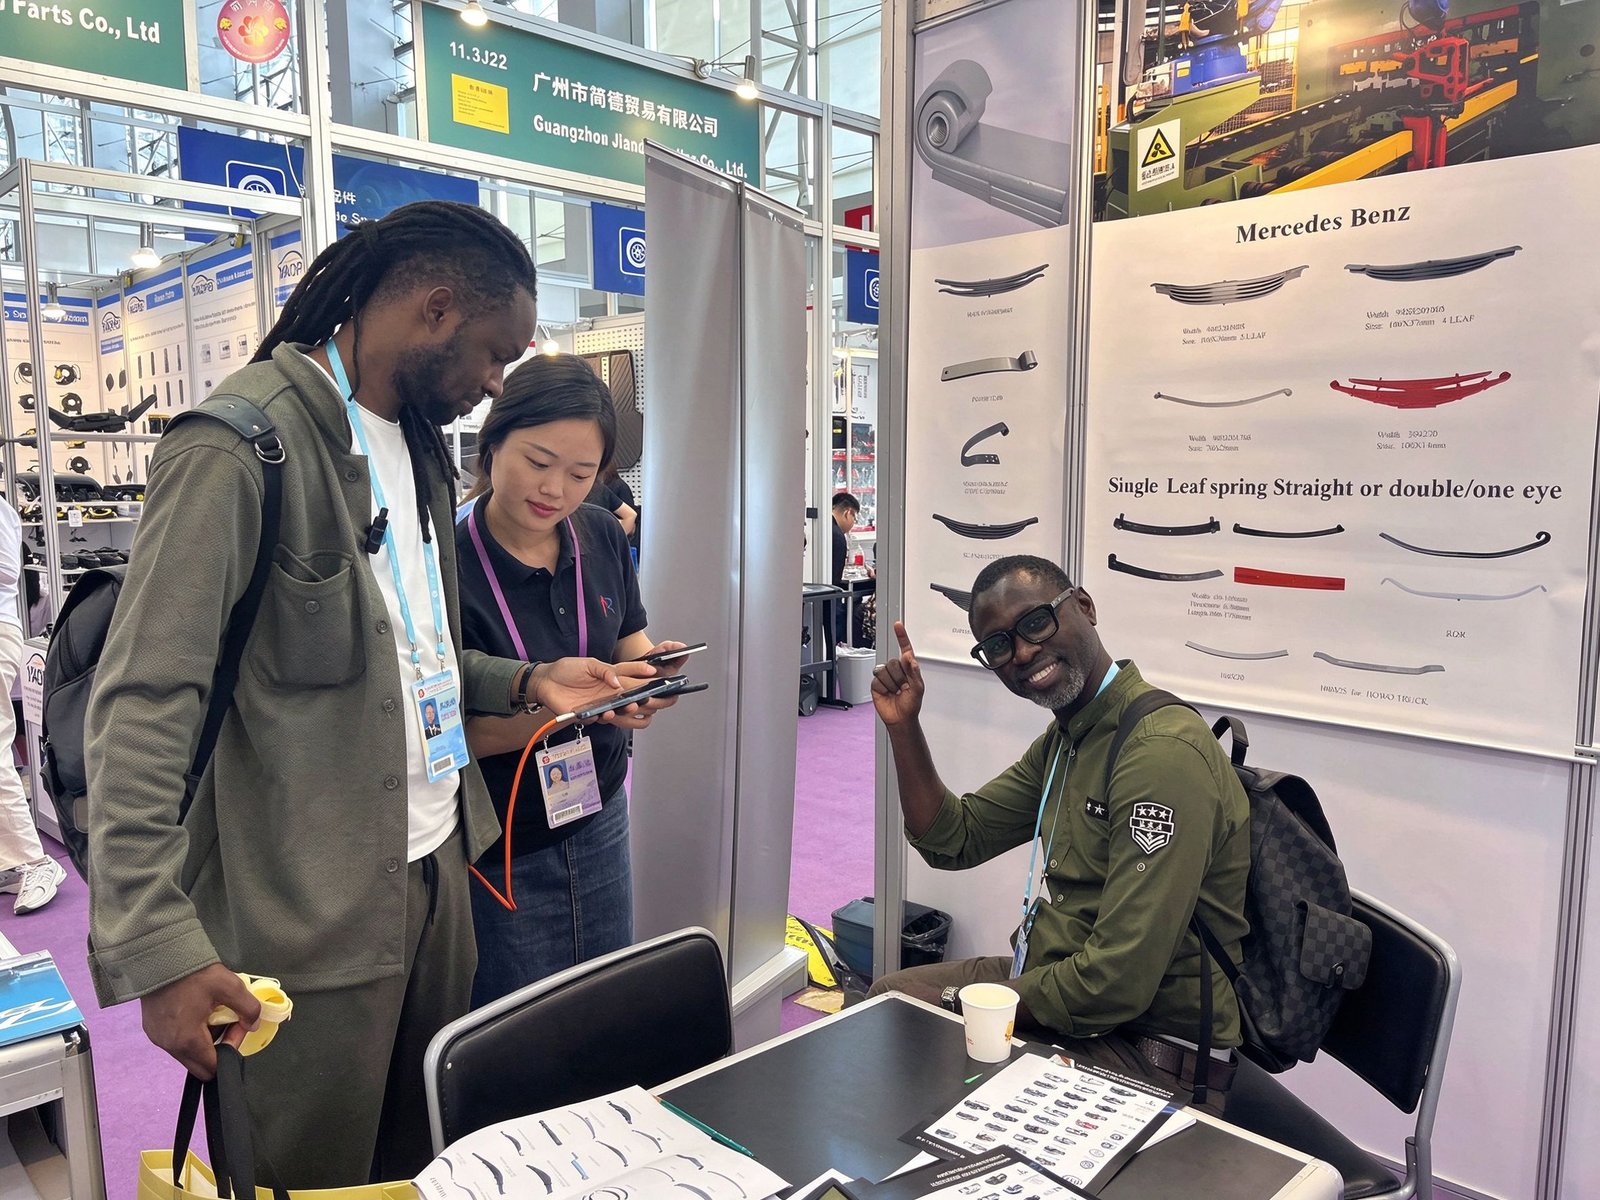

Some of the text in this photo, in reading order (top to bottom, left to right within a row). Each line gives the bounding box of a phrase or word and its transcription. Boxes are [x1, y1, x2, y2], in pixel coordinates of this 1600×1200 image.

[79, 7, 121, 40] Co.,
[126, 17, 161, 44] Ltd
[449, 41, 508, 70] 11.3J22
[532, 72, 718, 138] 广州市简德贸易有限公司
[726, 160, 748, 179] Ltd.
[1236, 206, 1411, 244] Mercedes Benz
[1167, 477, 1208, 494] Leaf
[1209, 477, 1268, 499] spring
[1273, 478, 1354, 501] Straight
[1360, 483, 1383, 497] or
[1389, 478, 1515, 499] double/one
[1522, 484, 1563, 505] eye
